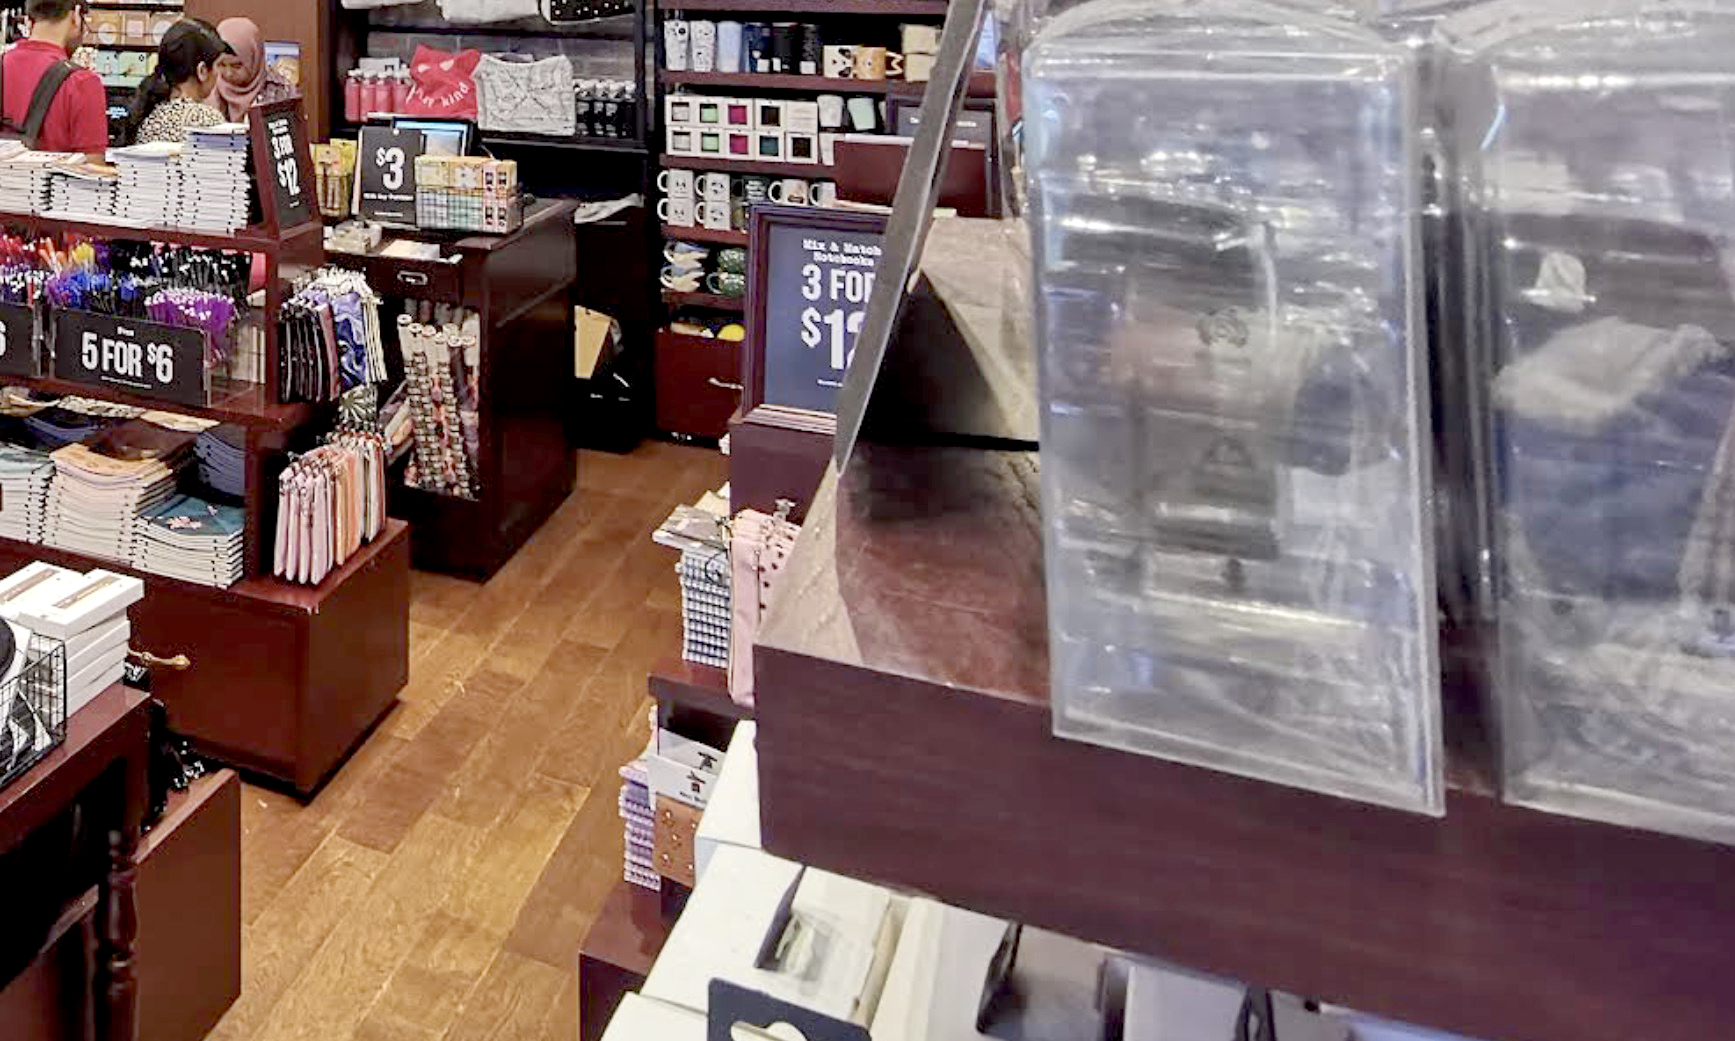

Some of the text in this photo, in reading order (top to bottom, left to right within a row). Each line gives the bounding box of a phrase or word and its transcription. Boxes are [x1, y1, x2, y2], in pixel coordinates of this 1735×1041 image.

[271, 136, 281, 159] 3
[277, 157, 301, 196] $12
[375, 146, 405, 191] $3
[802, 238, 882, 256] Mix & Match
[802, 263, 822, 301] 3
[81, 331, 173, 383] 5 FOR $6
